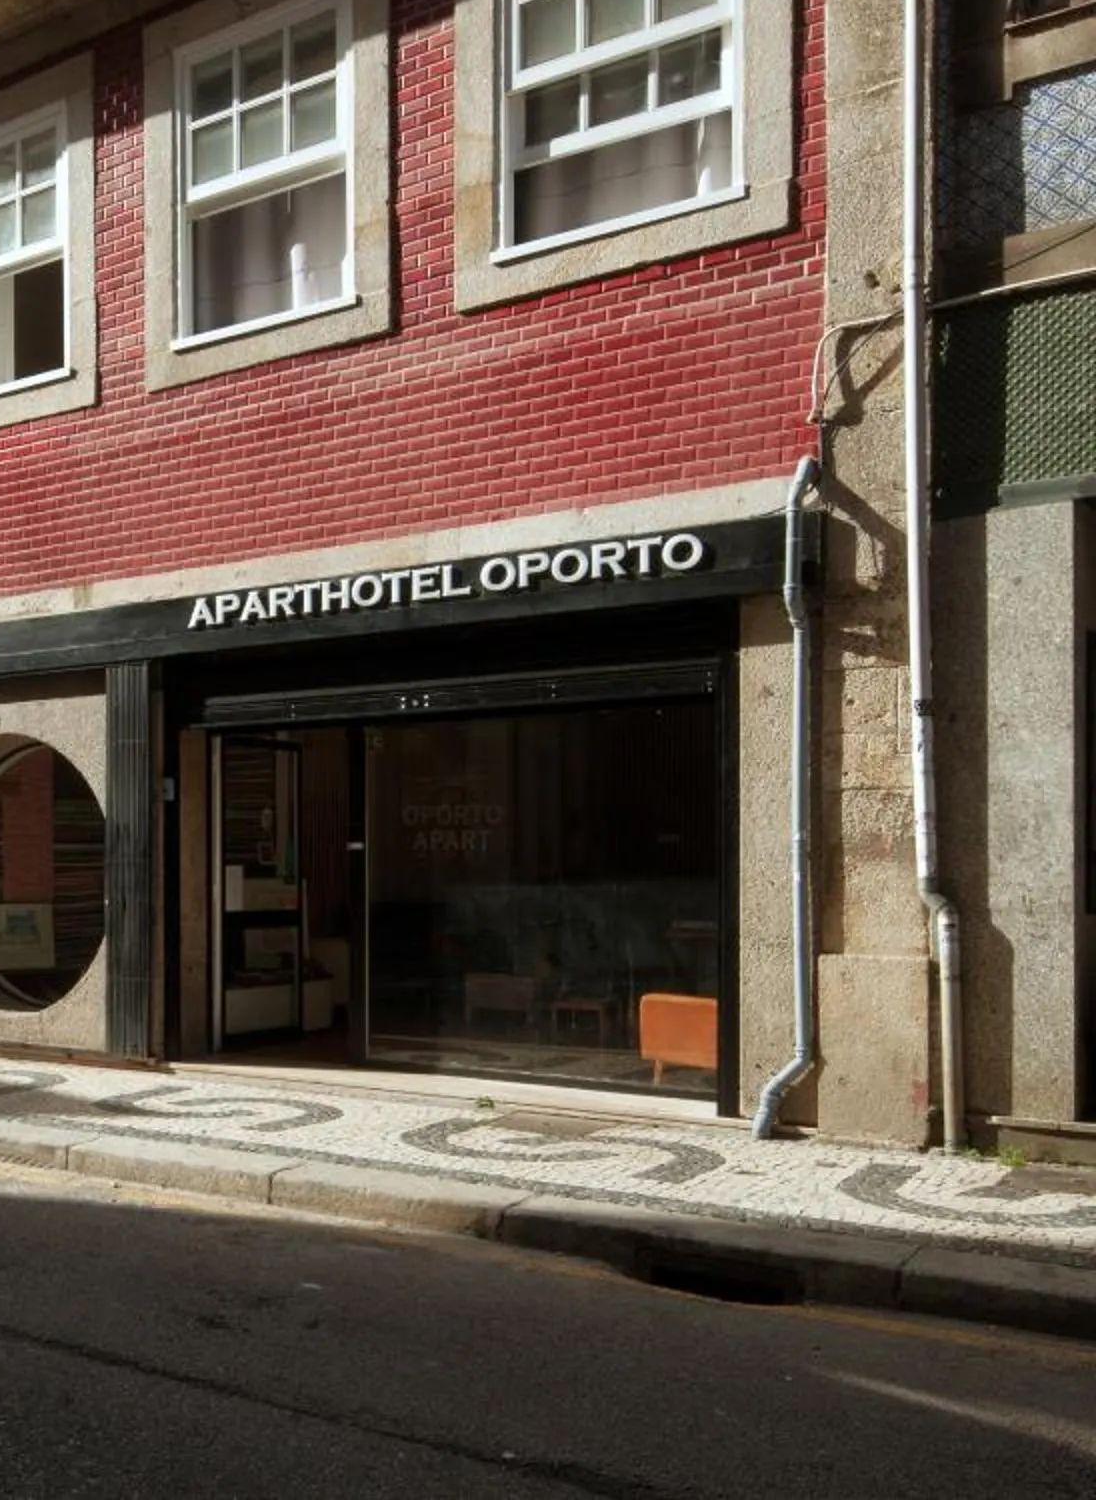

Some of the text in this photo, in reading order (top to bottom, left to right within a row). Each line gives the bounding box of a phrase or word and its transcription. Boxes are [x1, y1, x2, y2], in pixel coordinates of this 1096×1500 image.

[187, 533, 704, 629] APARTHOTEL OPORTO
[402, 803, 503, 826] OPORTO
[412, 828, 493, 852] APART
